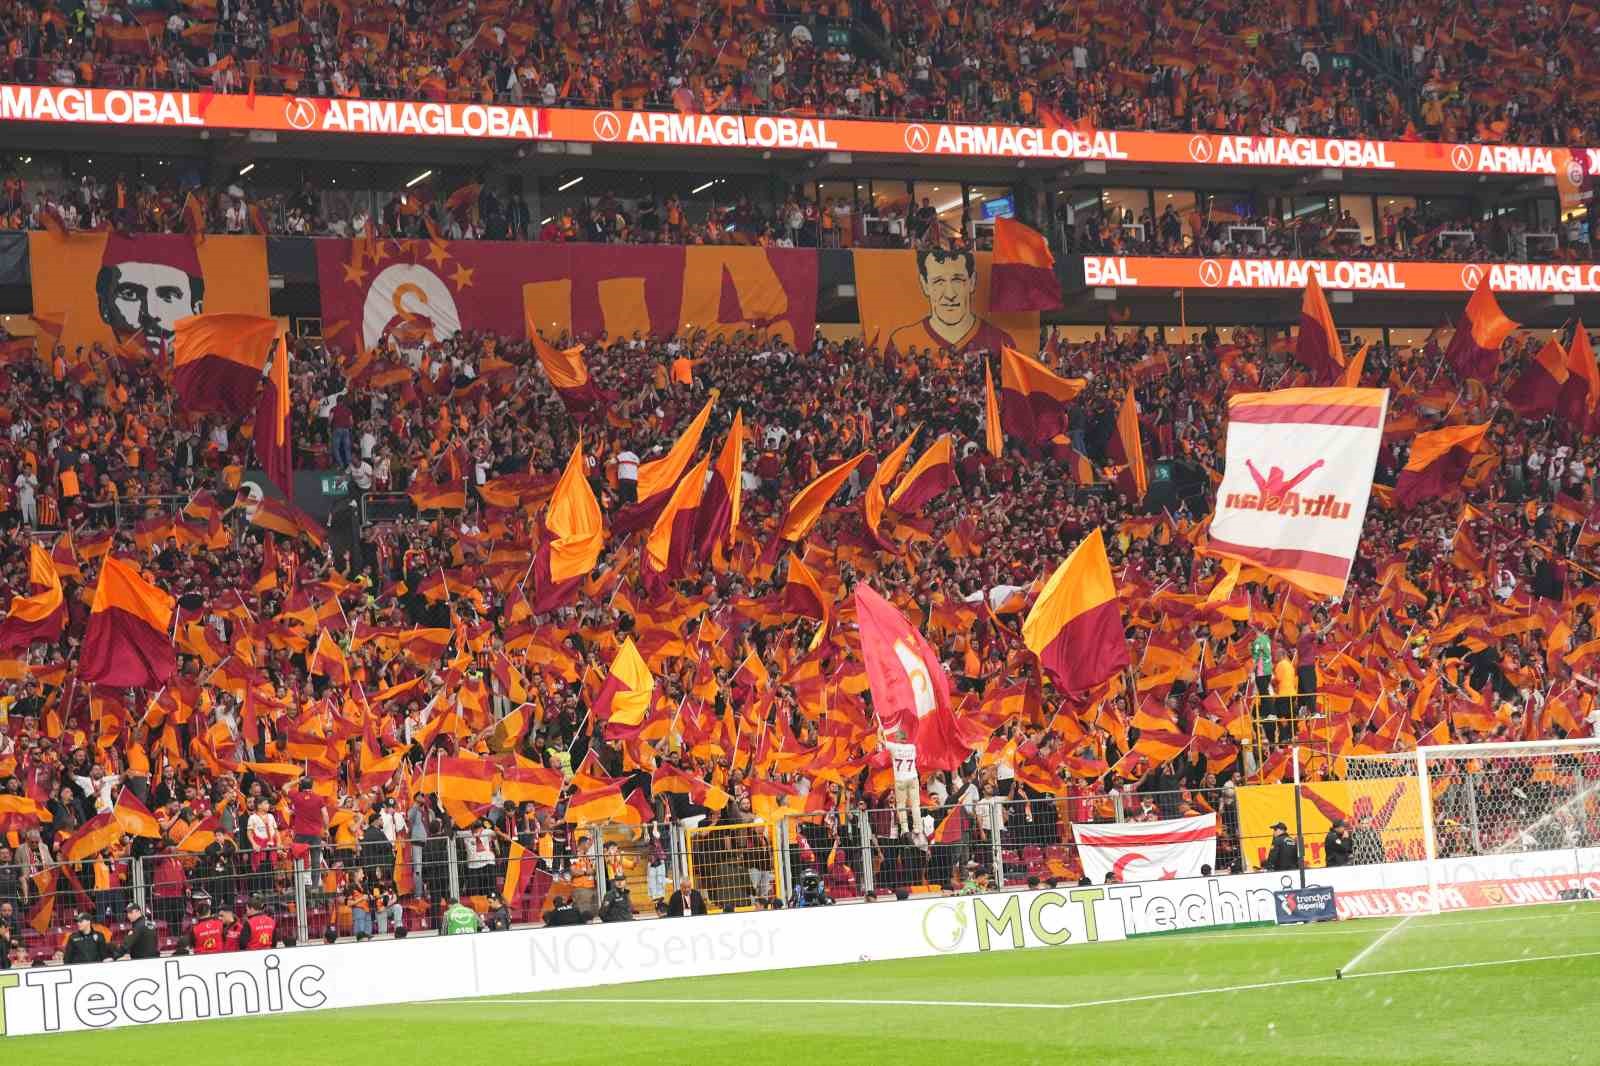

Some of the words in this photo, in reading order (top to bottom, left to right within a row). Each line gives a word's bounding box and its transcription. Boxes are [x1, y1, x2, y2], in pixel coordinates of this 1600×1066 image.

[0, 86, 204, 125] MAGLOBAL
[322, 100, 552, 138] ARMAGLOBAL
[626, 113, 837, 148] ARMAGLOBAL
[934, 126, 1128, 158] ARMAGLOBAL
[1217, 136, 1395, 167] ARMAGLOBAL
[1477, 145, 1600, 174] ARMA
[1083, 256, 1137, 285] BAL
[1227, 260, 1405, 289] ARMAGLOBAL
[1488, 264, 1600, 292] ARMAGLO
[895, 758, 914, 773] 77
[972, 886, 1105, 952] MCT
[1108, 875, 1320, 938] Techn
[1296, 893, 1332, 903] trendyol
[530, 930, 625, 977] NOx
[636, 920, 782, 968] Sensör
[26, 954, 328, 1032] Technic
